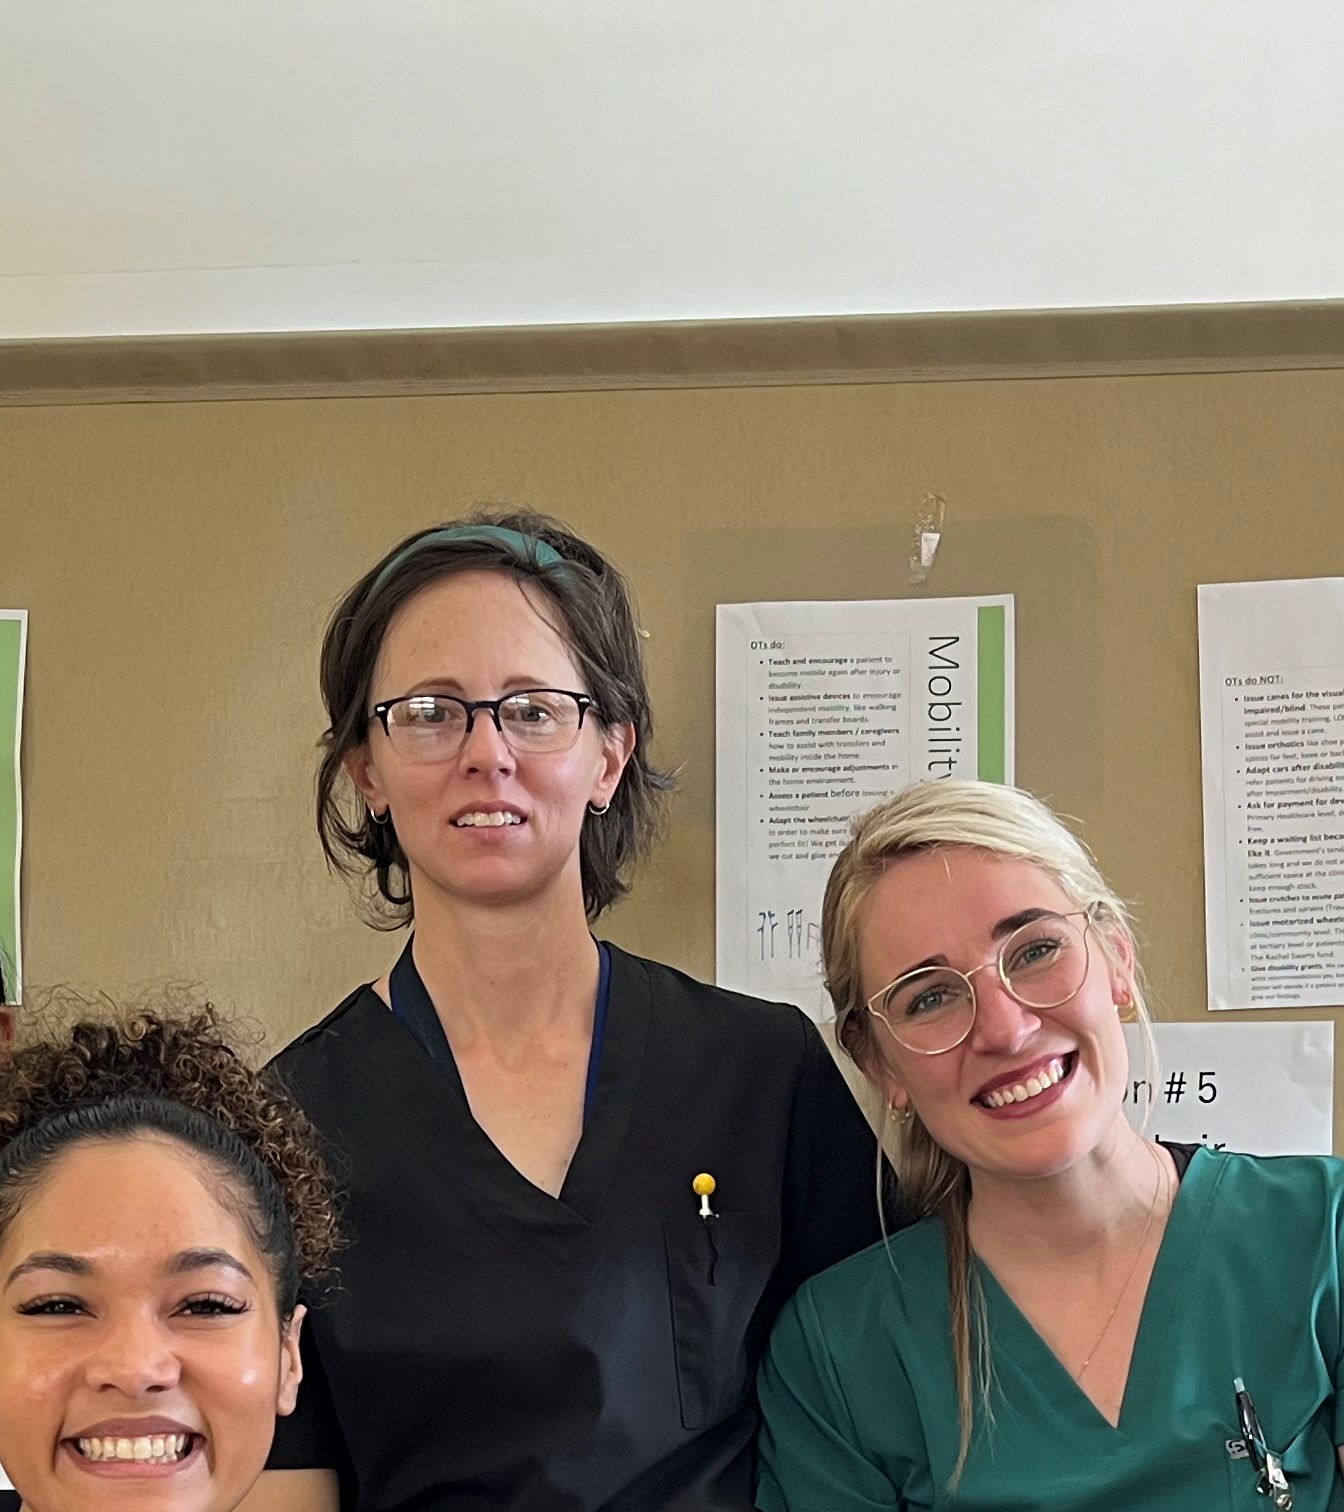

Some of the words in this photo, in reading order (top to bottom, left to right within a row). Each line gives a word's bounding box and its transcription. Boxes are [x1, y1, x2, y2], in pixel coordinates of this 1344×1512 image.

[751, 641, 767, 649] OTs
[1225, 677, 1242, 686] OTs
[1245, 677, 1257, 685] do
[1246, 767, 1270, 775] Adapt
[831, 789, 860, 798] before
[1278, 800, 1313, 809] payment
[1198, 1071, 1218, 1104] 5
